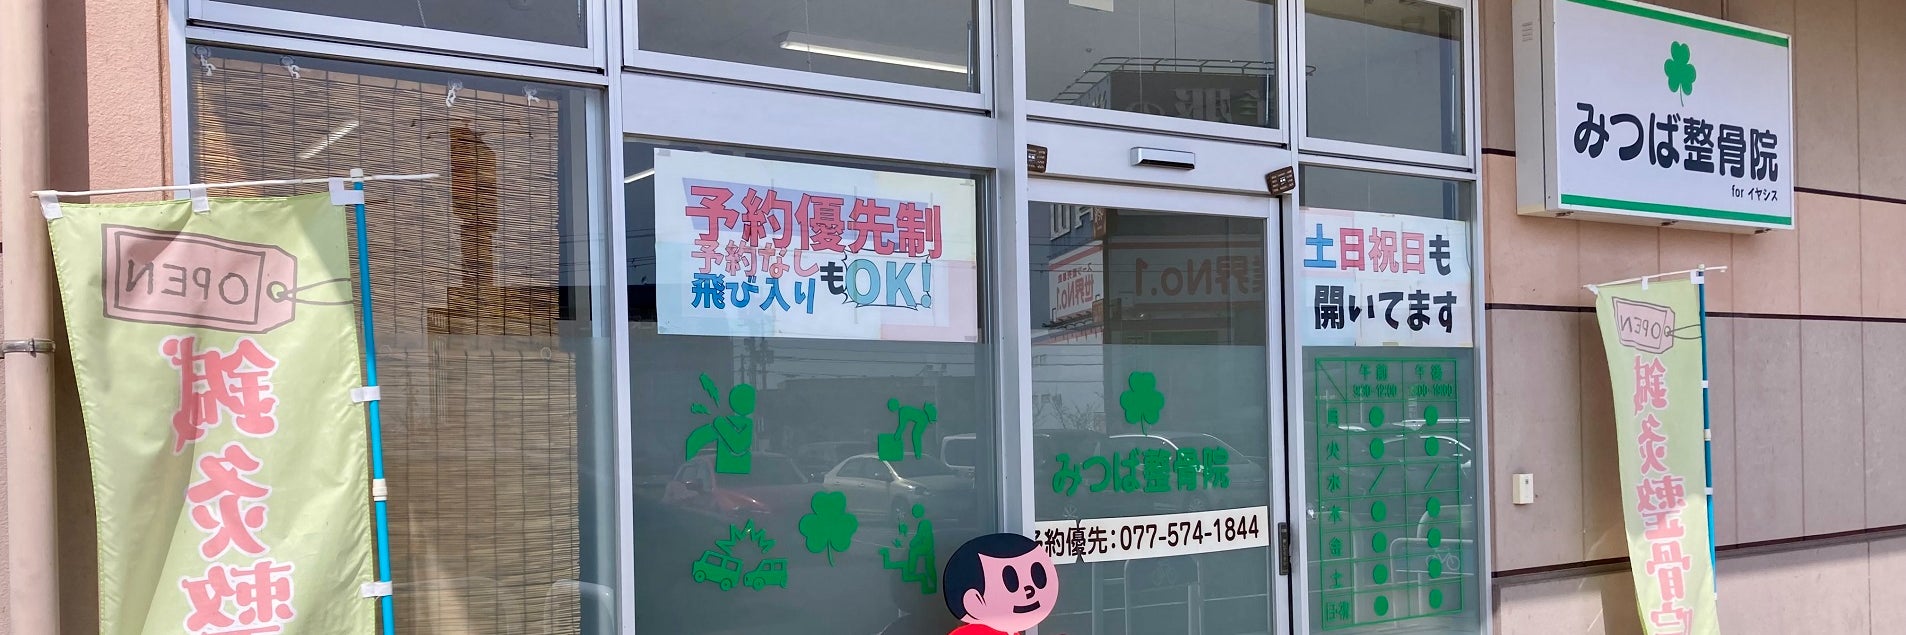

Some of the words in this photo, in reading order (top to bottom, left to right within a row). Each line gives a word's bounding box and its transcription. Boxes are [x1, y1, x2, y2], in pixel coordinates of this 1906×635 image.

[1573, 102, 1778, 182] みつば整骨院
[1731, 184, 1744, 198] for
[1747, 187, 1778, 202] イヤシス
[685, 185, 943, 260] 予約優先制
[691, 238, 819, 279] 予約なし
[1303, 223, 1452, 276] 土日祝日も
[691, 272, 816, 315] 飛び入り
[1314, 284, 1458, 334] 開いてます
[1326, 440, 1340, 461] 火
[1052, 446, 1230, 497] みつば整骨院
[1327, 472, 1341, 493] 水
[1328, 504, 1343, 524] 木
[1329, 536, 1343, 557] 金
[1330, 568, 1343, 589] 土
